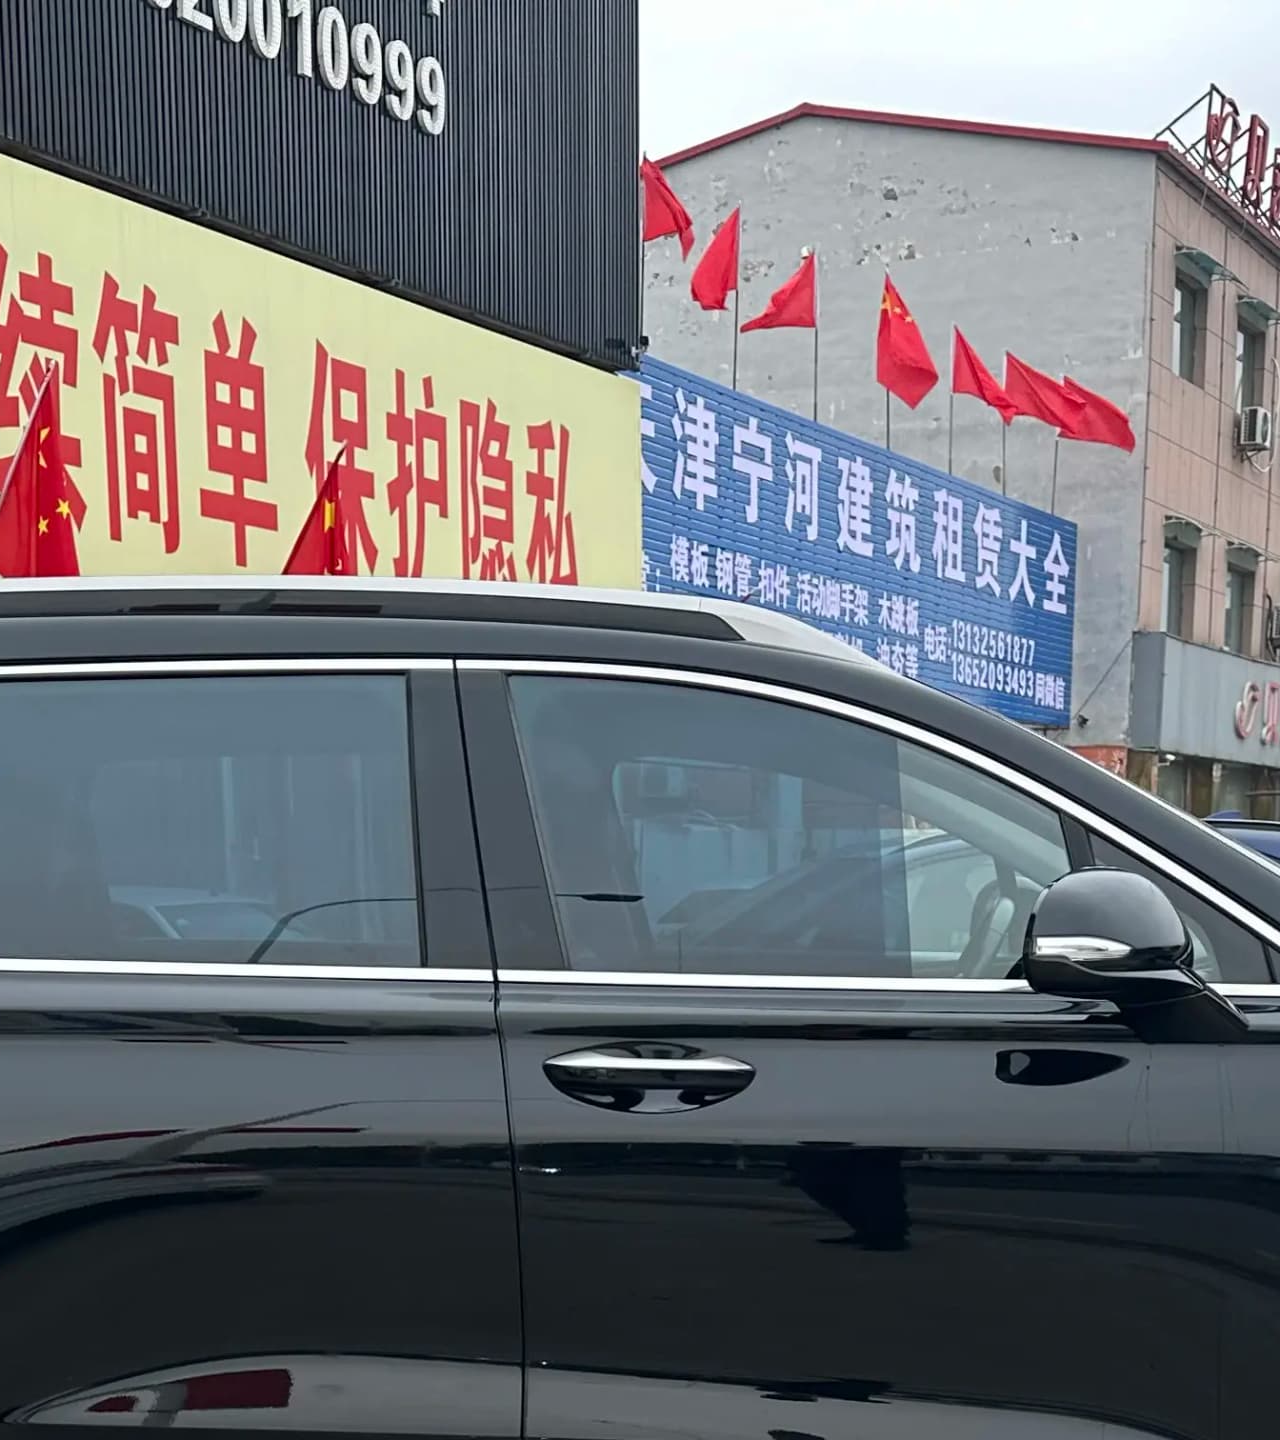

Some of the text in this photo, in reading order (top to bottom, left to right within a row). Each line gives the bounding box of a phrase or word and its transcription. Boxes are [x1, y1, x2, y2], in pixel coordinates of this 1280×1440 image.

[303, 338, 581, 588] 保护隐私
[669, 533, 710, 589] 模板
[714, 546, 754, 598] 钢管
[757, 558, 791, 605] 扣件
[795, 571, 870, 627] 活动脚手架
[952, 619, 1035, 666] 13132561877
